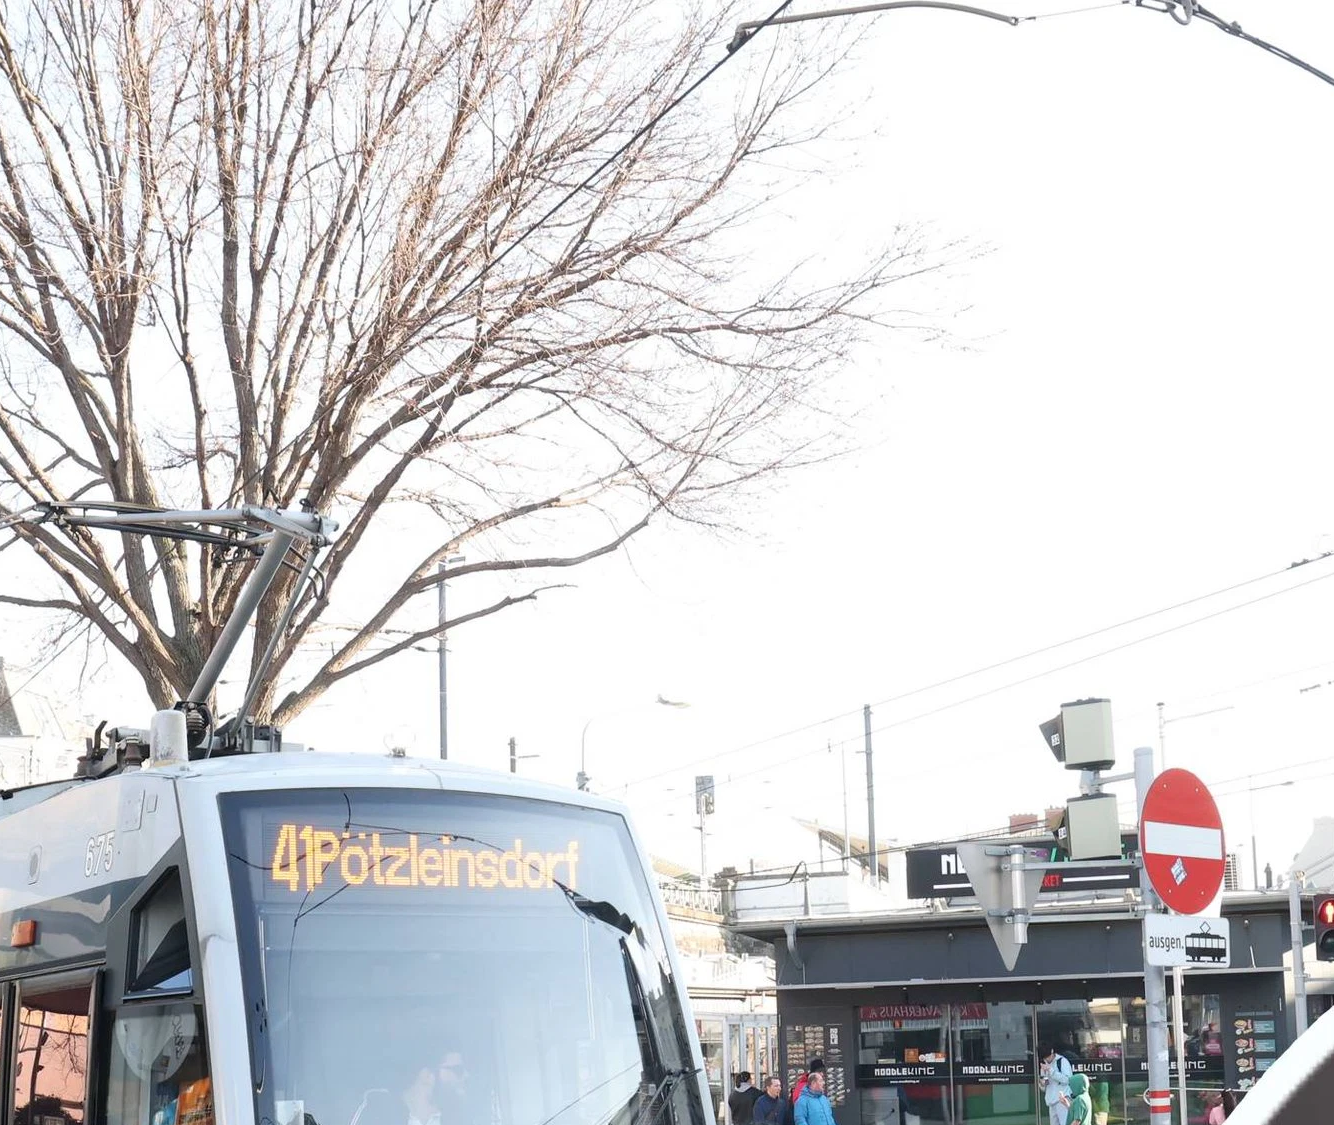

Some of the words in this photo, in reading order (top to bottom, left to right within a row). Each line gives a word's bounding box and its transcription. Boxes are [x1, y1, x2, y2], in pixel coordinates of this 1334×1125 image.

[85, 830, 115, 877] 675
[272, 824, 314, 892] 41
[314, 831, 579, 889] Pötzleinsdorf
[1149, 936, 1184, 952] ausgen.
[874, 1066, 935, 1076] NOODLEKING
[962, 1065, 1024, 1075] NOODLEKING
[1072, 1063, 1113, 1073] LEKING
